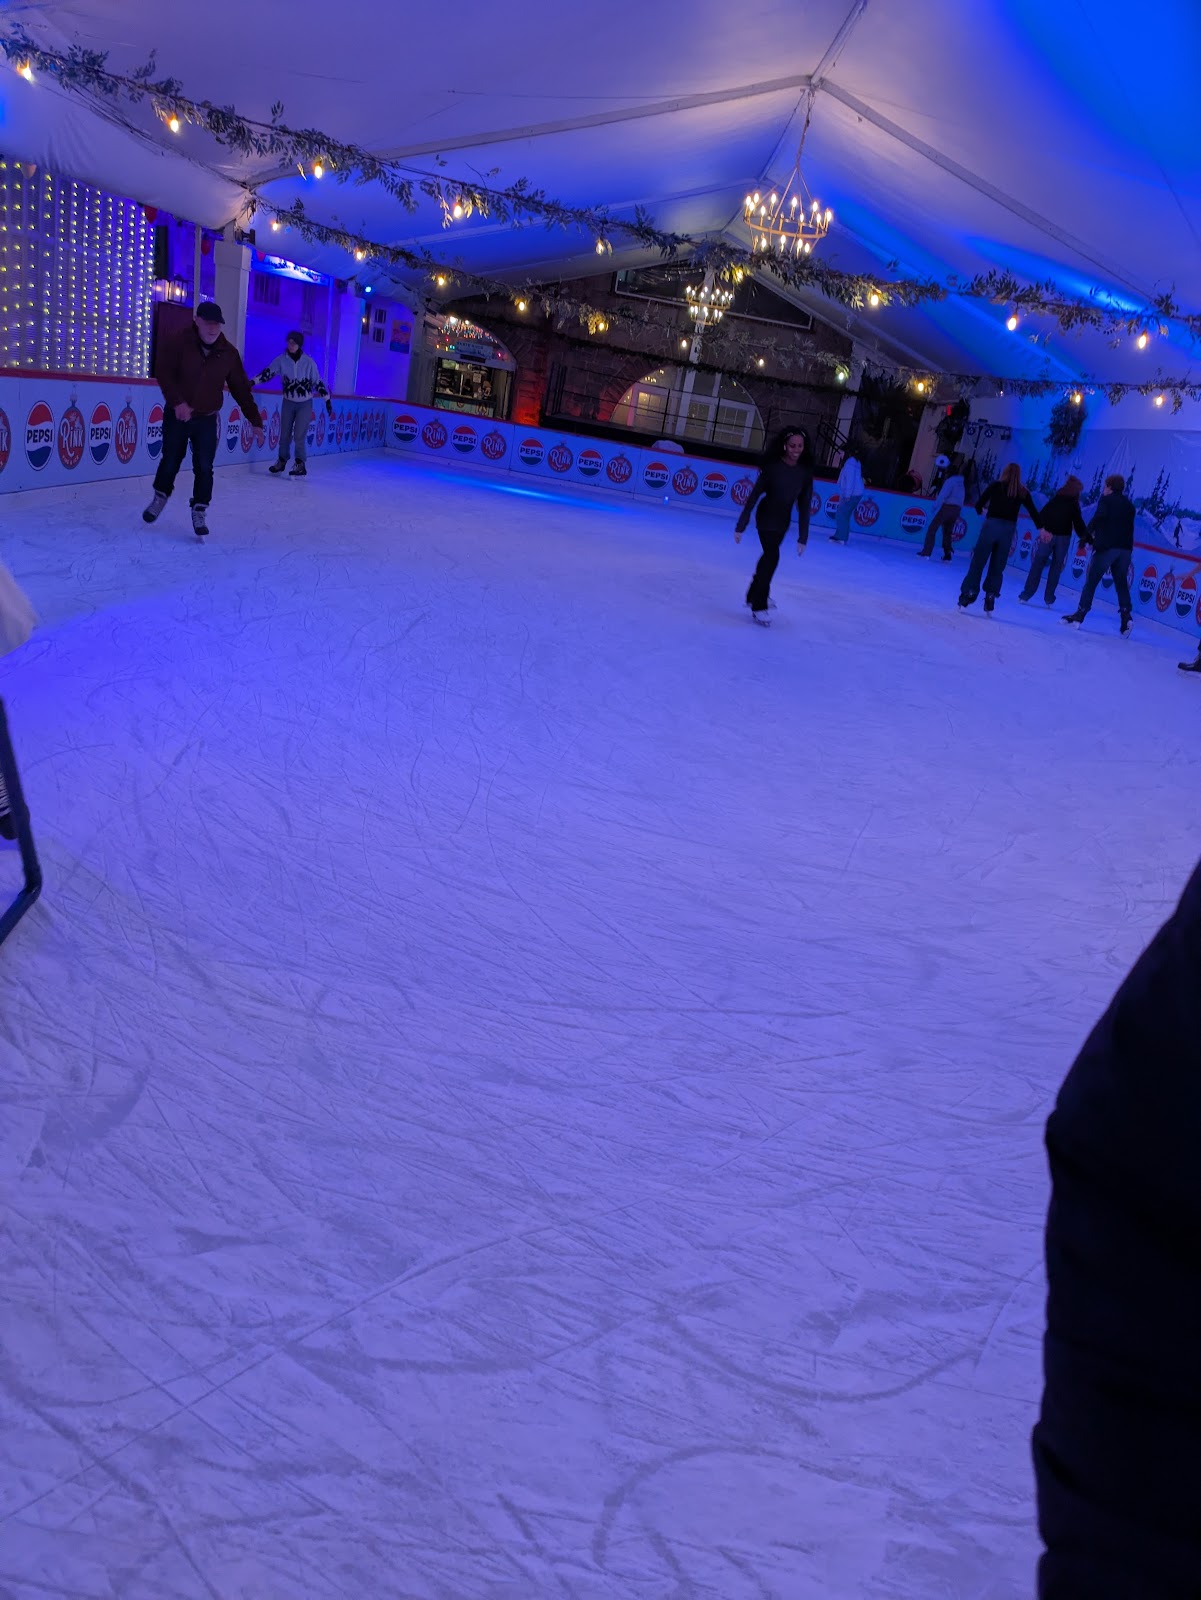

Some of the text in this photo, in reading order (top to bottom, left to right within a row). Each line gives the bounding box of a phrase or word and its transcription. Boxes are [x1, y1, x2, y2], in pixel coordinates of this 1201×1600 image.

[148, 426, 163, 437] PEPS
[394, 423, 418, 433] PEPSI
[27, 428, 53, 443] PEPSI
[91, 427, 111, 440] PEPSI
[453, 434, 476, 444] PEPSI
[519, 447, 543, 457] PEPSI
[578, 458, 602, 468] PEPSI
[645, 470, 668, 480] PEPSI
[703, 481, 727, 491] PEPSI
[902, 516, 925, 526] PEPSI
[1140, 578, 1155, 591] PEPSI
[1178, 590, 1195, 604] PEPSI
